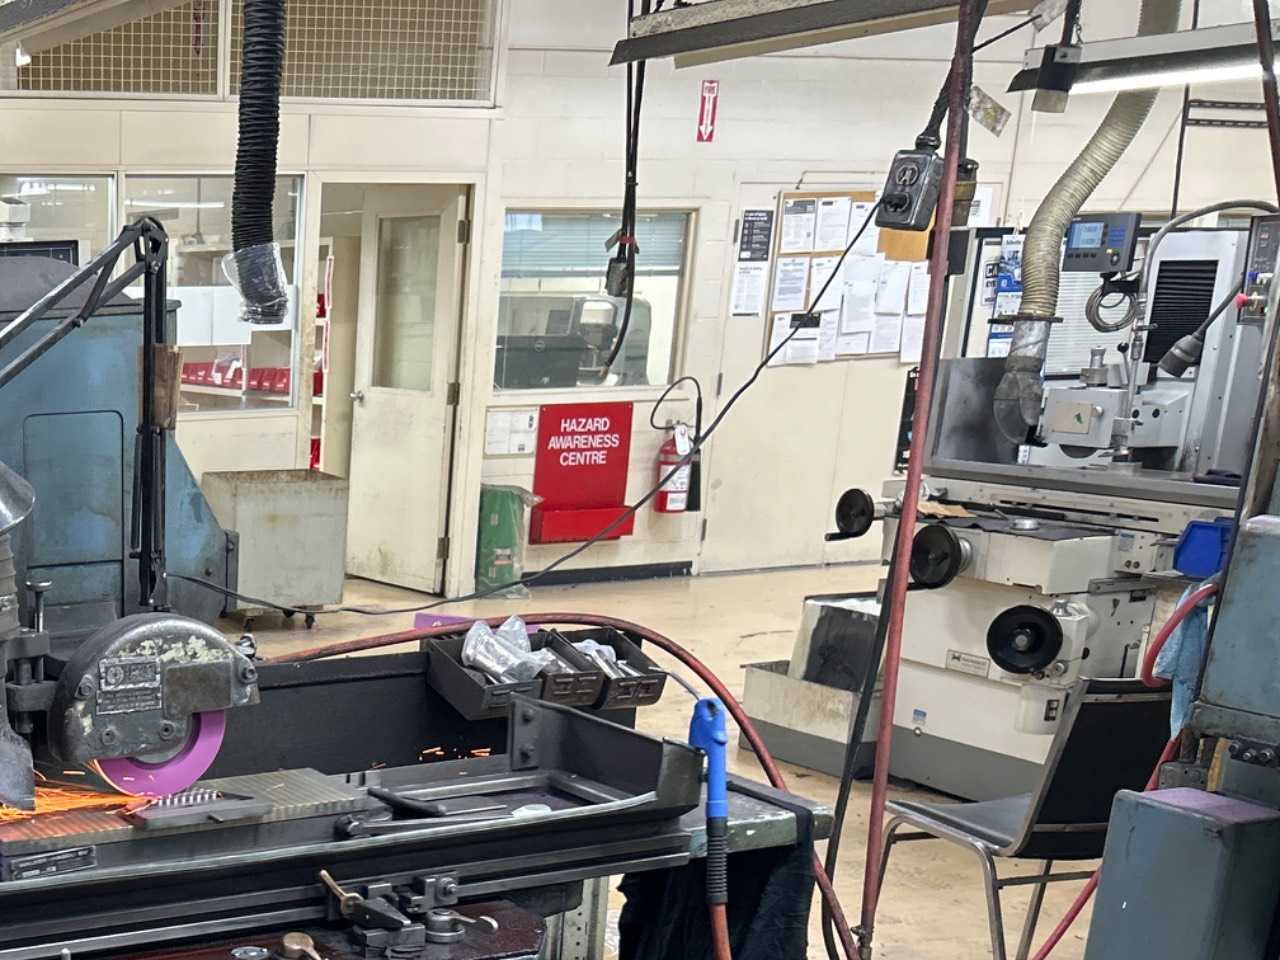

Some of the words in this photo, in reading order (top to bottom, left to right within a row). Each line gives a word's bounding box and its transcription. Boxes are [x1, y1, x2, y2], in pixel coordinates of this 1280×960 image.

[561, 417, 610, 432] HAZARD
[548, 434, 620, 450] AWARENESS
[560, 451, 607, 466] CENTRE
